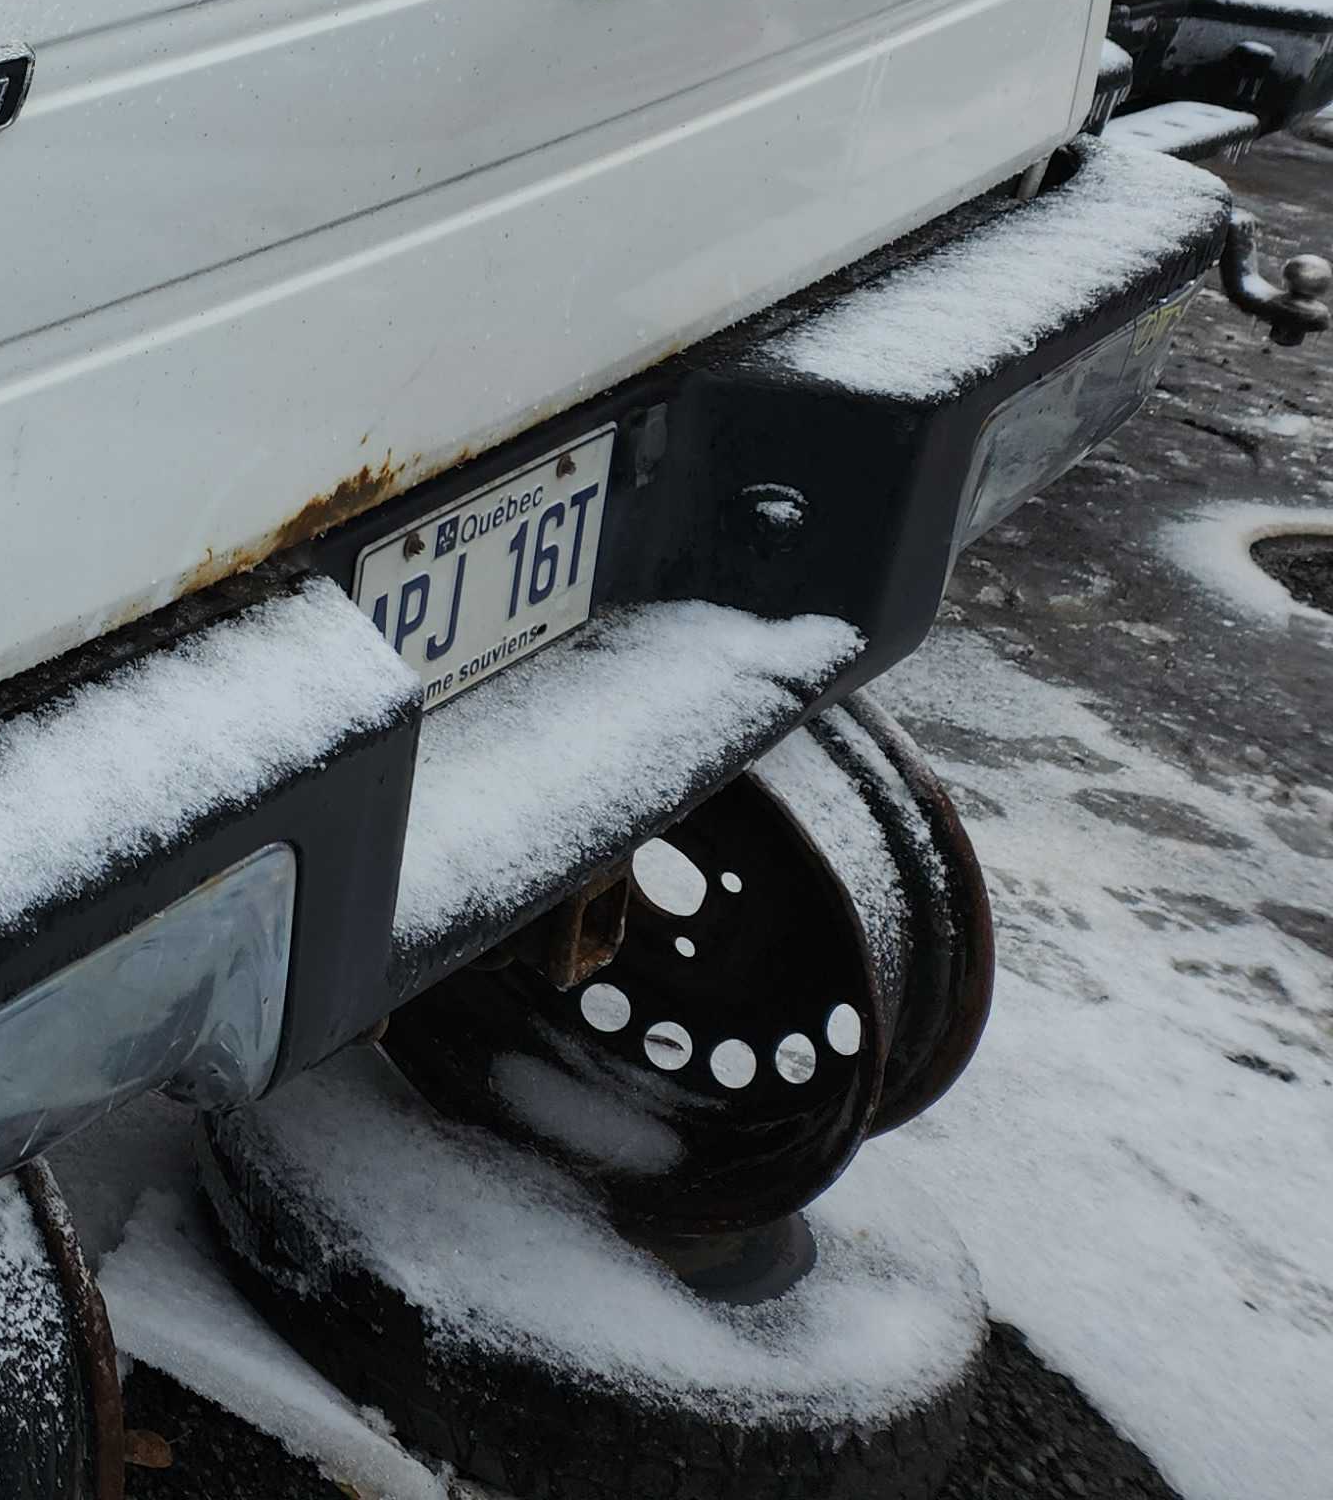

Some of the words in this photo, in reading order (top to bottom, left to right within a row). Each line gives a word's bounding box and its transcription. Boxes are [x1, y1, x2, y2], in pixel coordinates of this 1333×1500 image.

[460, 485, 544, 544] Québec
[507, 482, 600, 621] 16T
[425, 672, 454, 699] me
[458, 622, 539, 683] souviens
